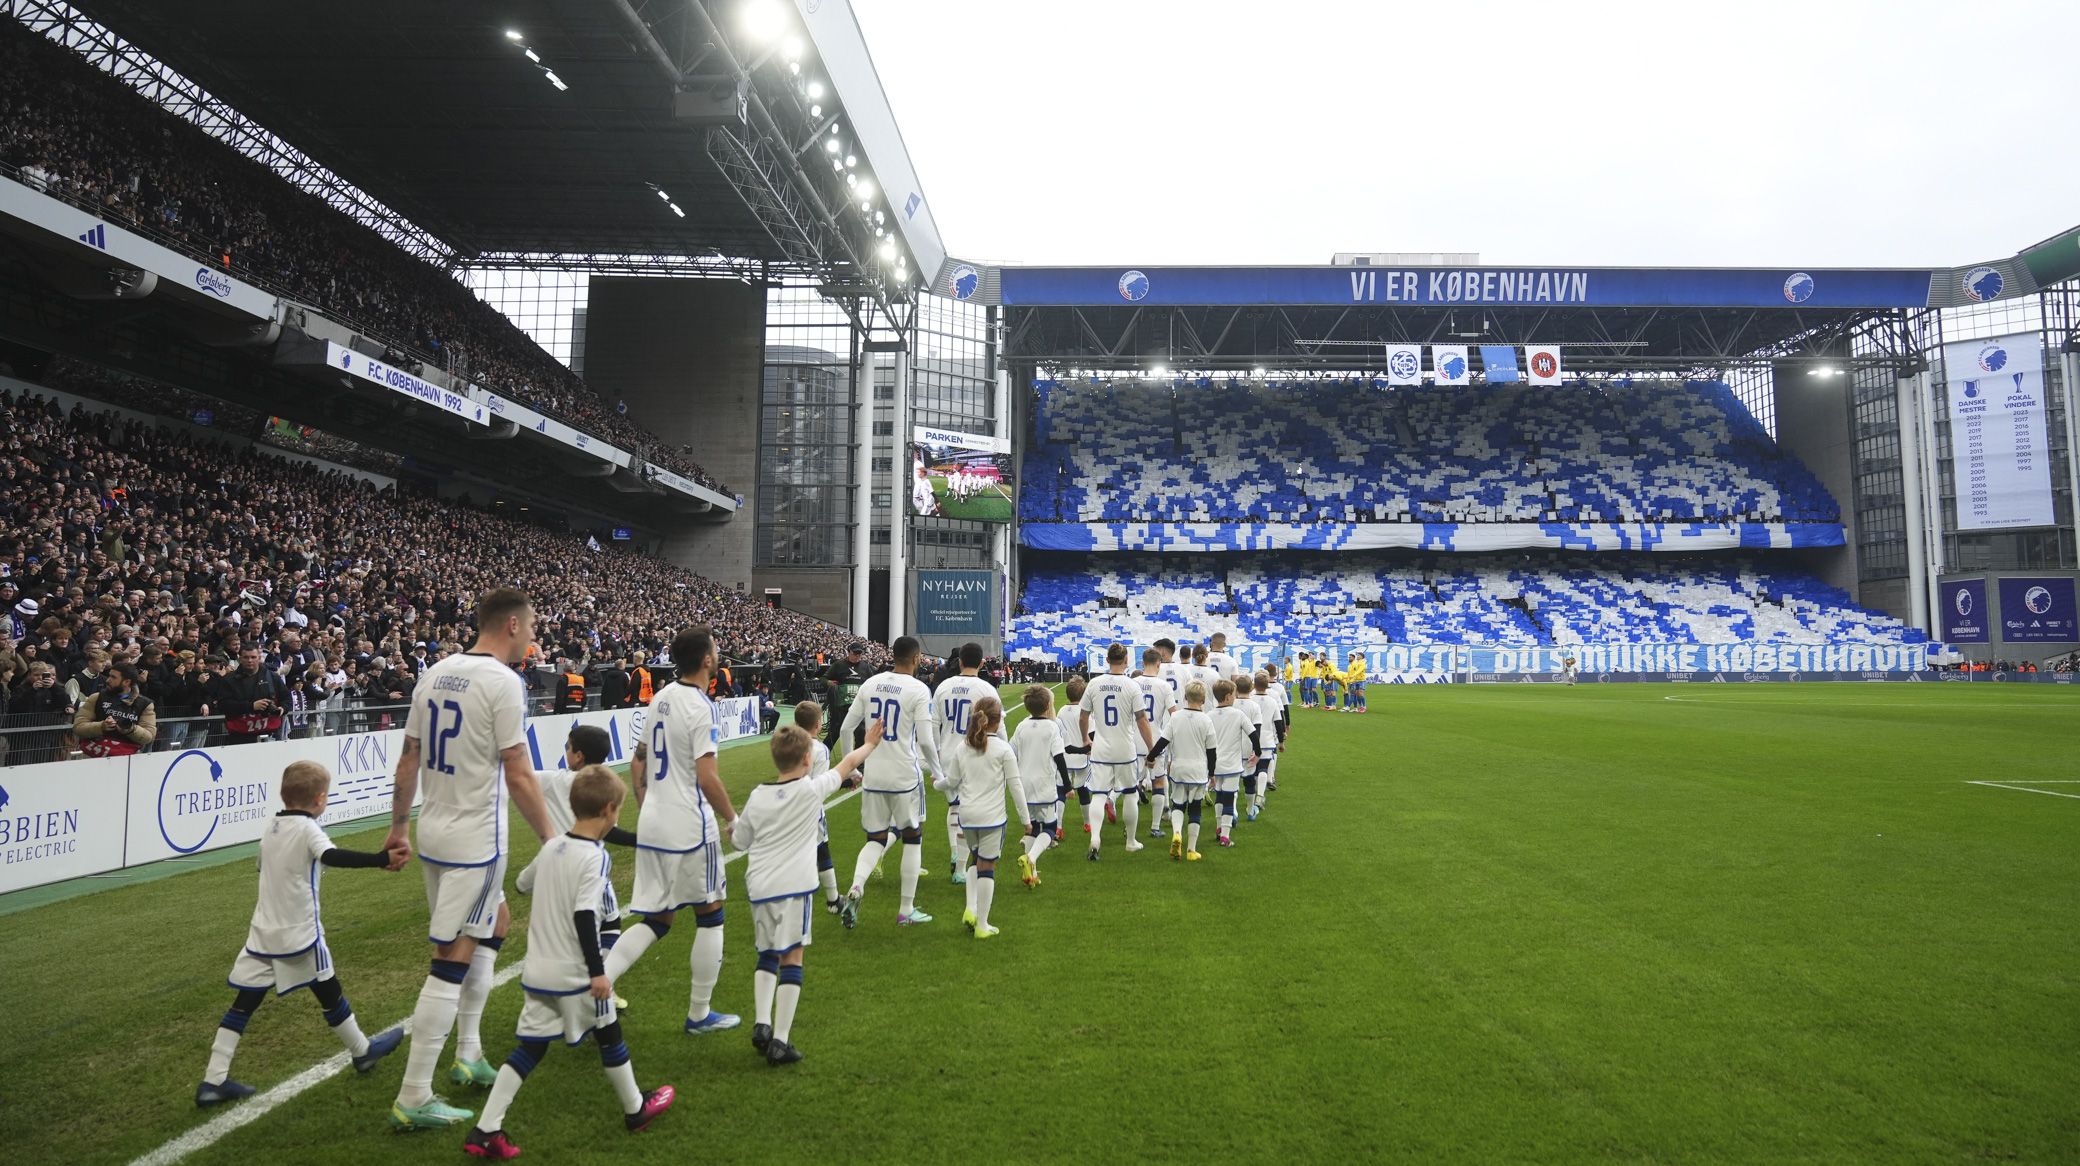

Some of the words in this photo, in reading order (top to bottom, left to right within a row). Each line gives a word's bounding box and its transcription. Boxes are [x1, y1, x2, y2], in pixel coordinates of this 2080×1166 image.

[196, 267, 231, 297] Carlsberg
[1351, 271, 1376, 301] VI
[1387, 272, 1418, 301] ER
[1429, 270, 1588, 303] KØBENHAVN
[367, 361, 384, 380] F.C.
[385, 368, 441, 403] KØBENHAVN
[444, 393, 462, 412] 1992
[1958, 399, 1987, 407] DANSKE
[1959, 406, 1987, 414] MESTRE
[2004, 400, 2037, 409] VINDERE
[926, 431, 963, 445] PARKEN
[922, 580, 987, 592] NYHAVN
[1951, 626, 1980, 634] KØBENHAVN
[1706, 642, 1924, 673] KØBENHAVN
[1743, 672, 1770, 682] Carlsberg
[1939, 672, 1969, 681] Carlsberg
[2053, 672, 2074, 680] UNIBET
[944, 698, 973, 735] 40
[1104, 694, 1118, 726] 6
[247, 718, 268, 732] 247
[427, 698, 463, 776] 12
[338, 733, 387, 775] KKN
[653, 721, 669, 780] 9
[175, 782, 268, 816] TREBBIEN
[221, 806, 267, 825] ELECTRIC
[6, 839, 76, 864] ELECTRIC
